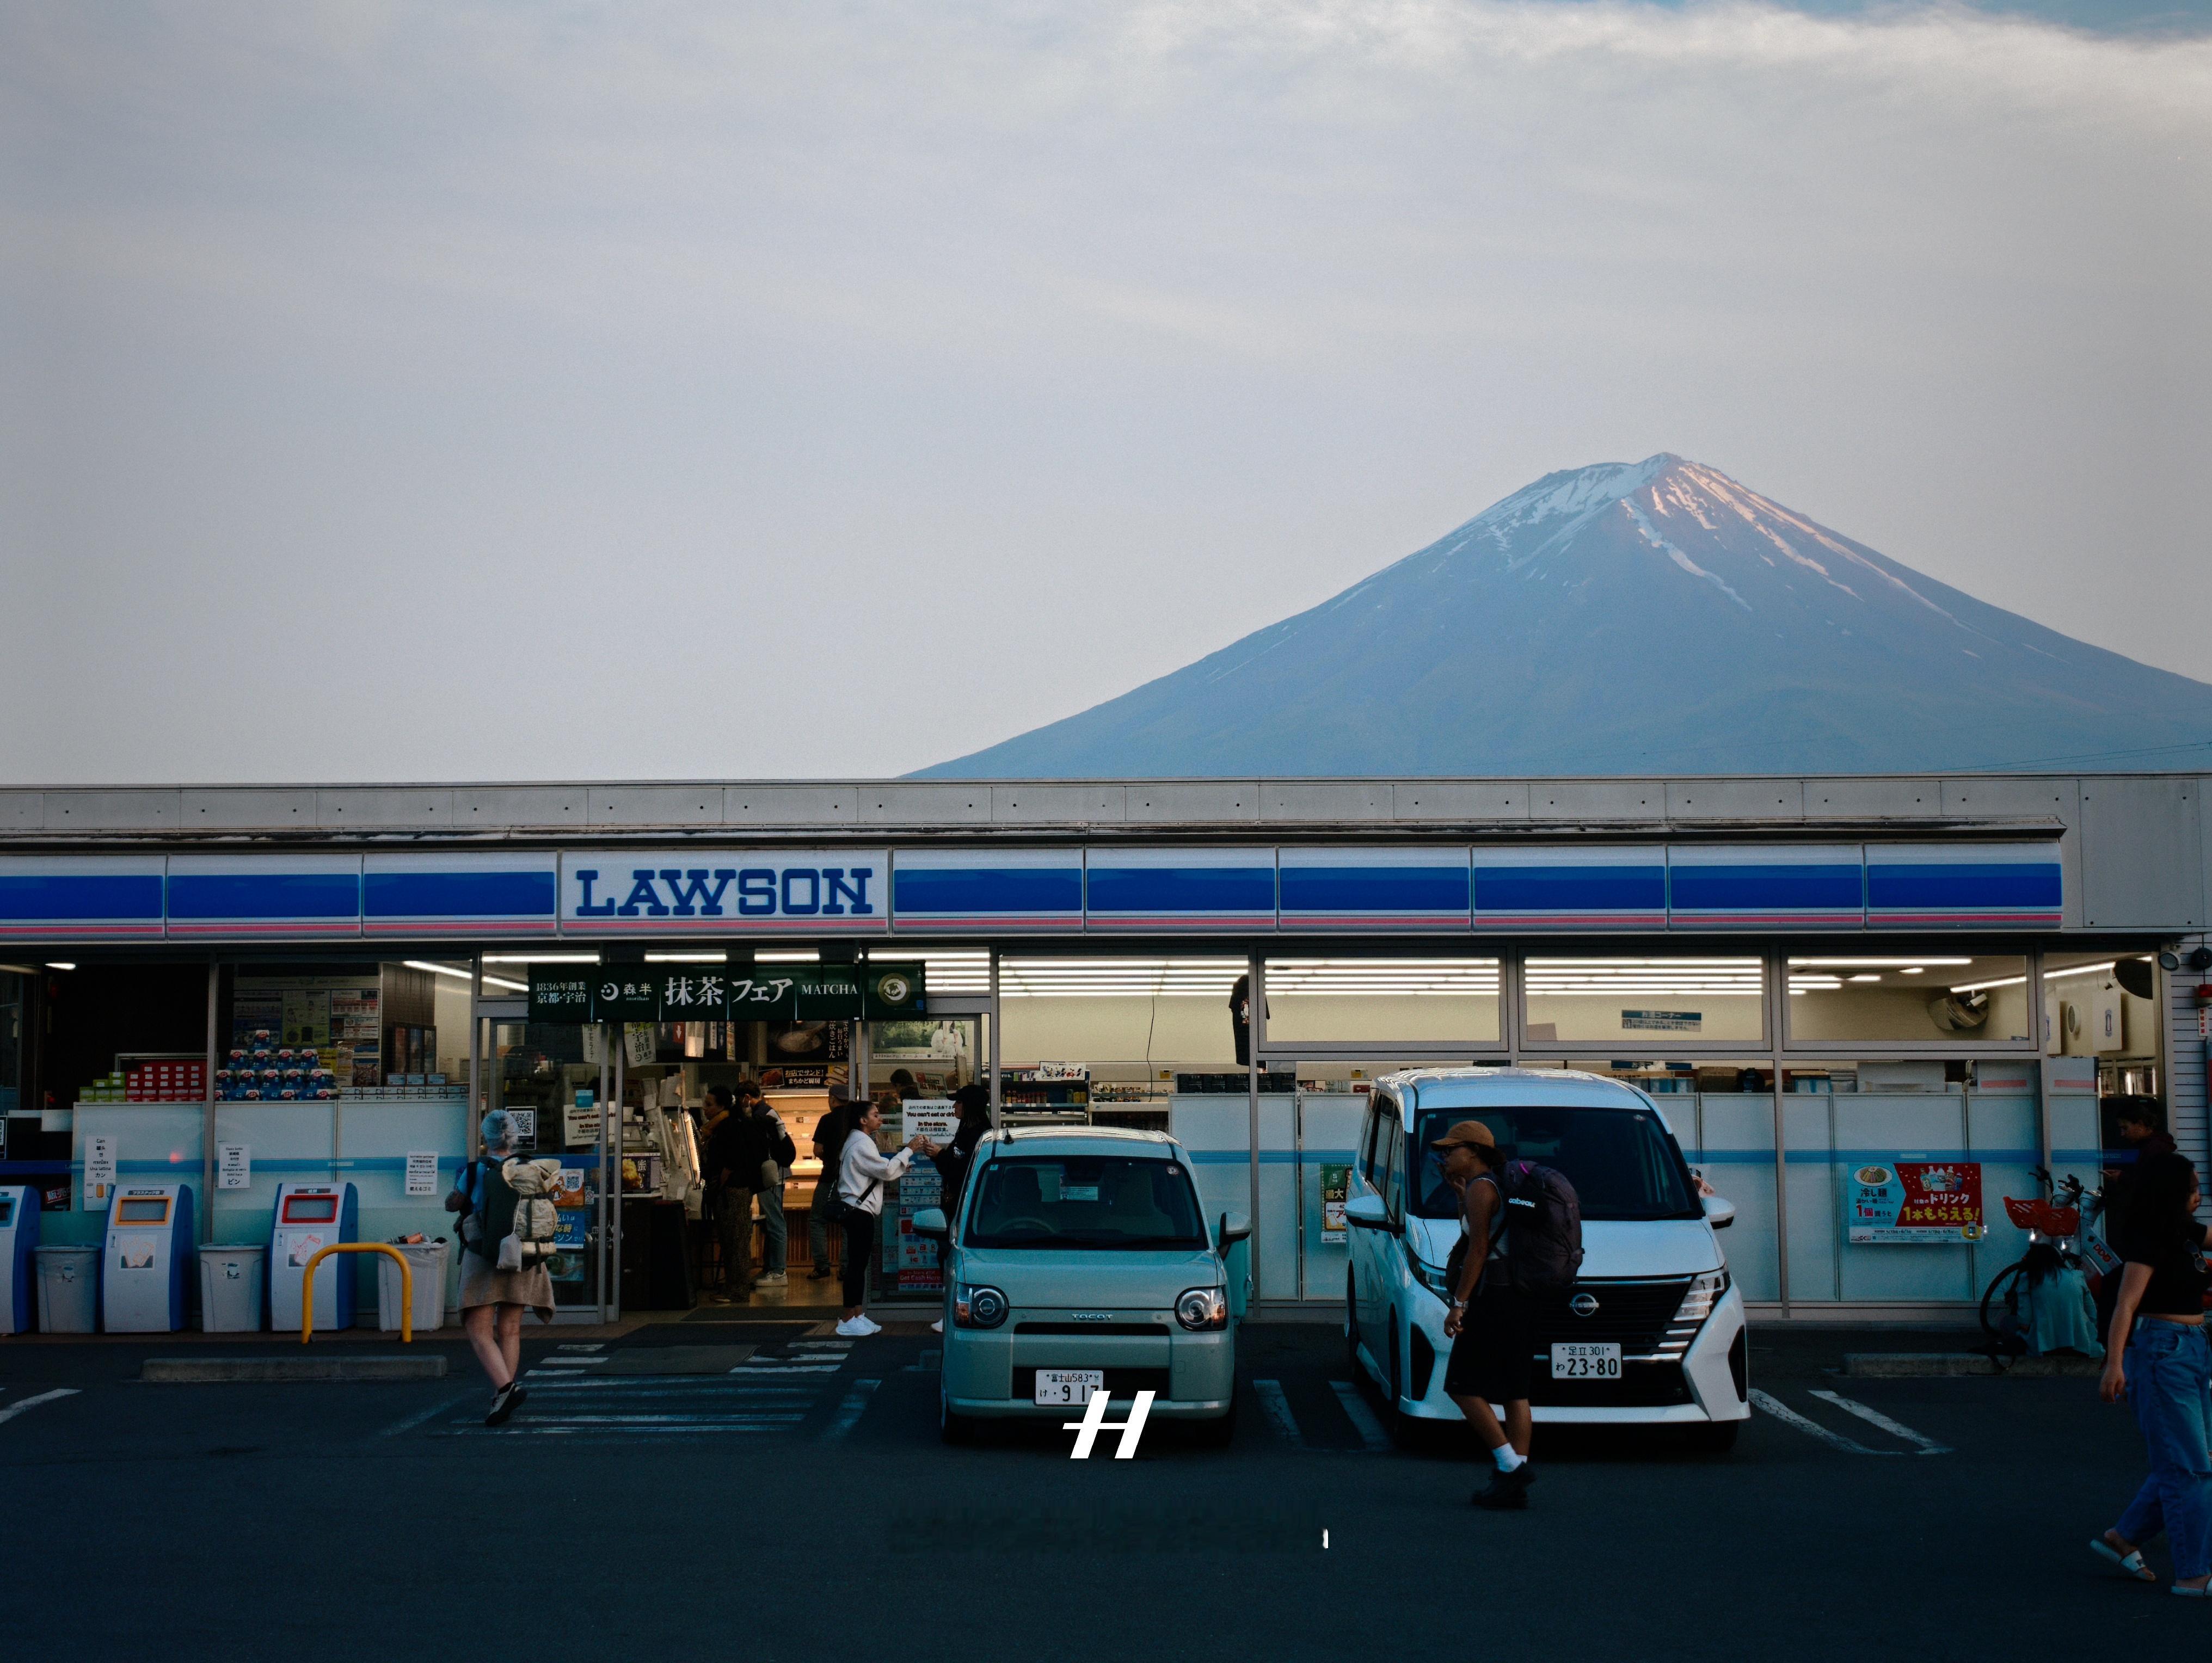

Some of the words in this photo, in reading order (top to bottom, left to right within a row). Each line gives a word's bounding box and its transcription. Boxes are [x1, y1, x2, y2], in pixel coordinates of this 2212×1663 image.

[576, 868, 872, 916] LAWSON
[536, 982, 587, 991] 1836年創業
[801, 984, 858, 995] MATCHA
[1568, 1346, 1587, 1356] 足立
[1589, 1346, 1604, 1356] 301
[1556, 1362, 1565, 1371] わ
[1567, 1358, 1617, 1376] 23-80
[1040, 1389, 1047, 1397] け
